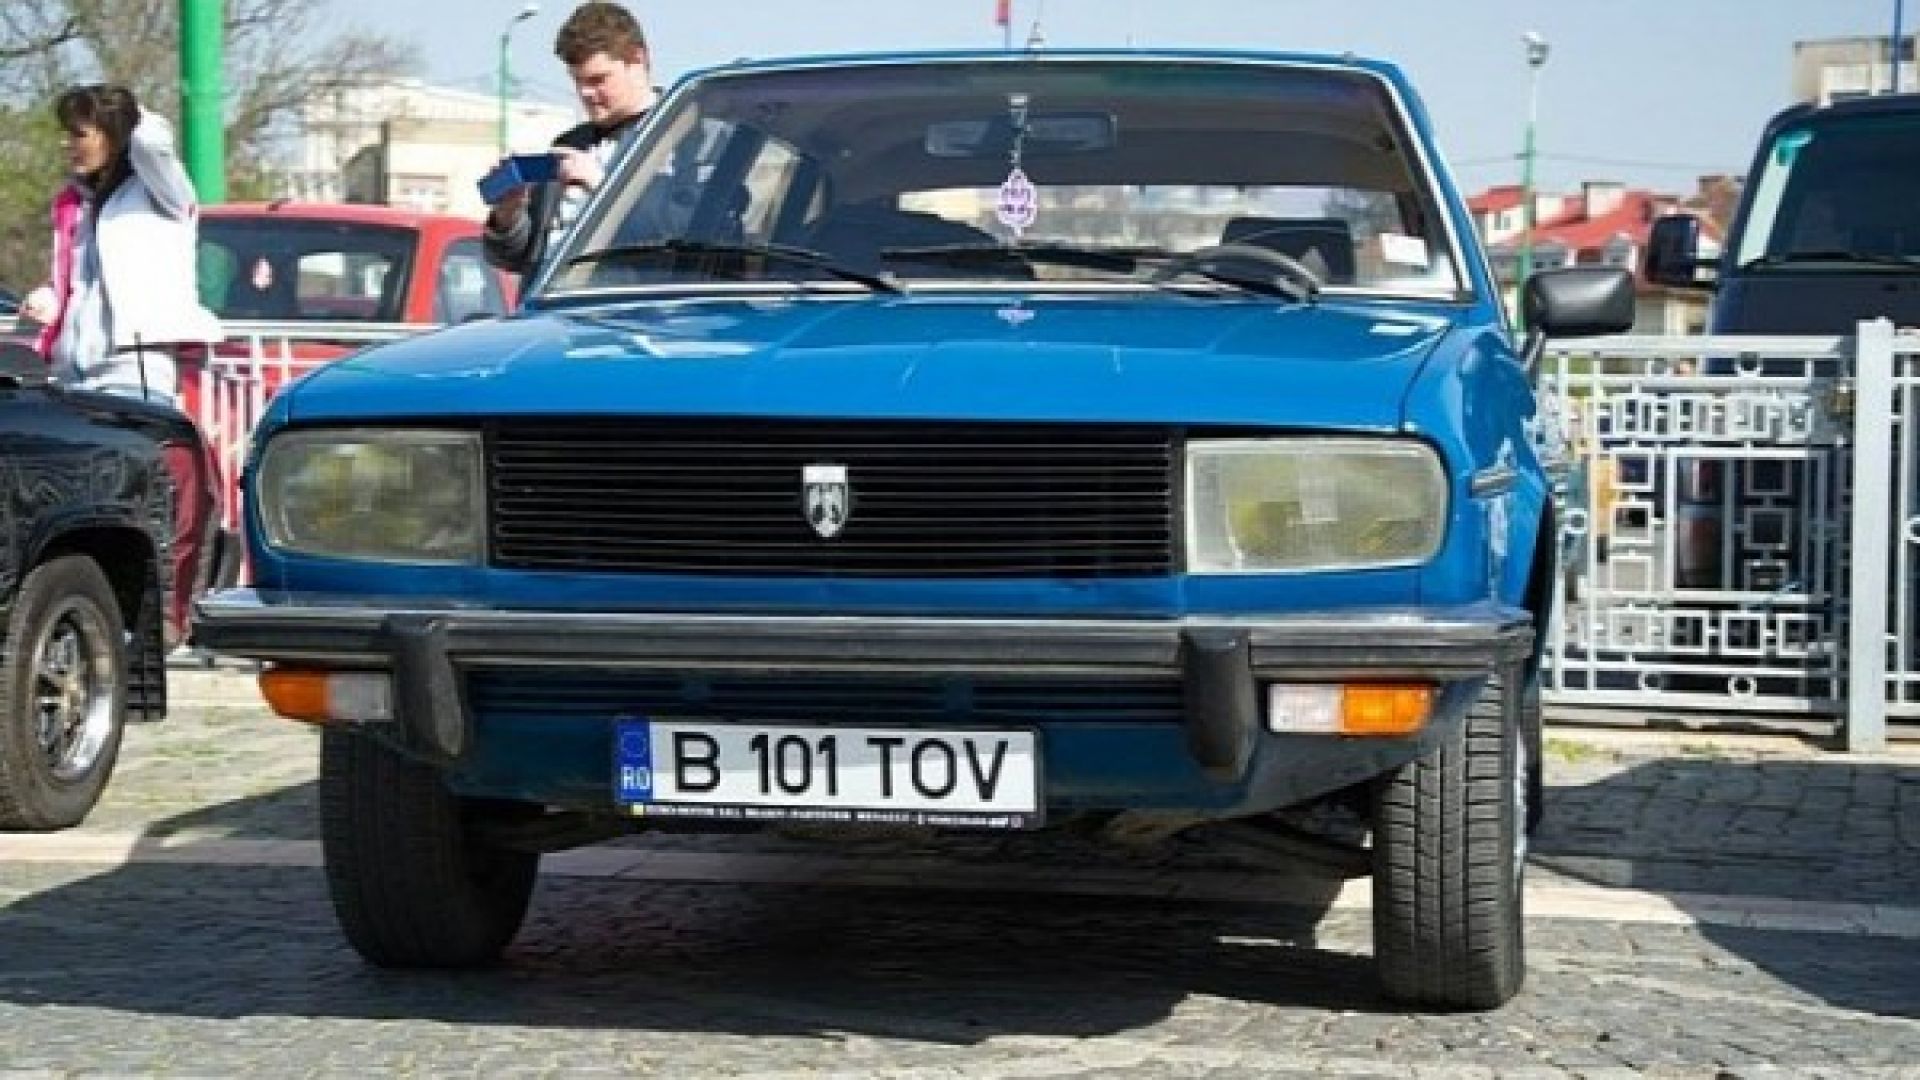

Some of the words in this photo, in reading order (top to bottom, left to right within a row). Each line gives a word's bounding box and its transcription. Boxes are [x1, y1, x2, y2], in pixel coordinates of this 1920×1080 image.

[621, 765, 651, 789] RO
[673, 732, 720, 792] B
[749, 734, 838, 796] 101
[866, 737, 1009, 802] TOV
